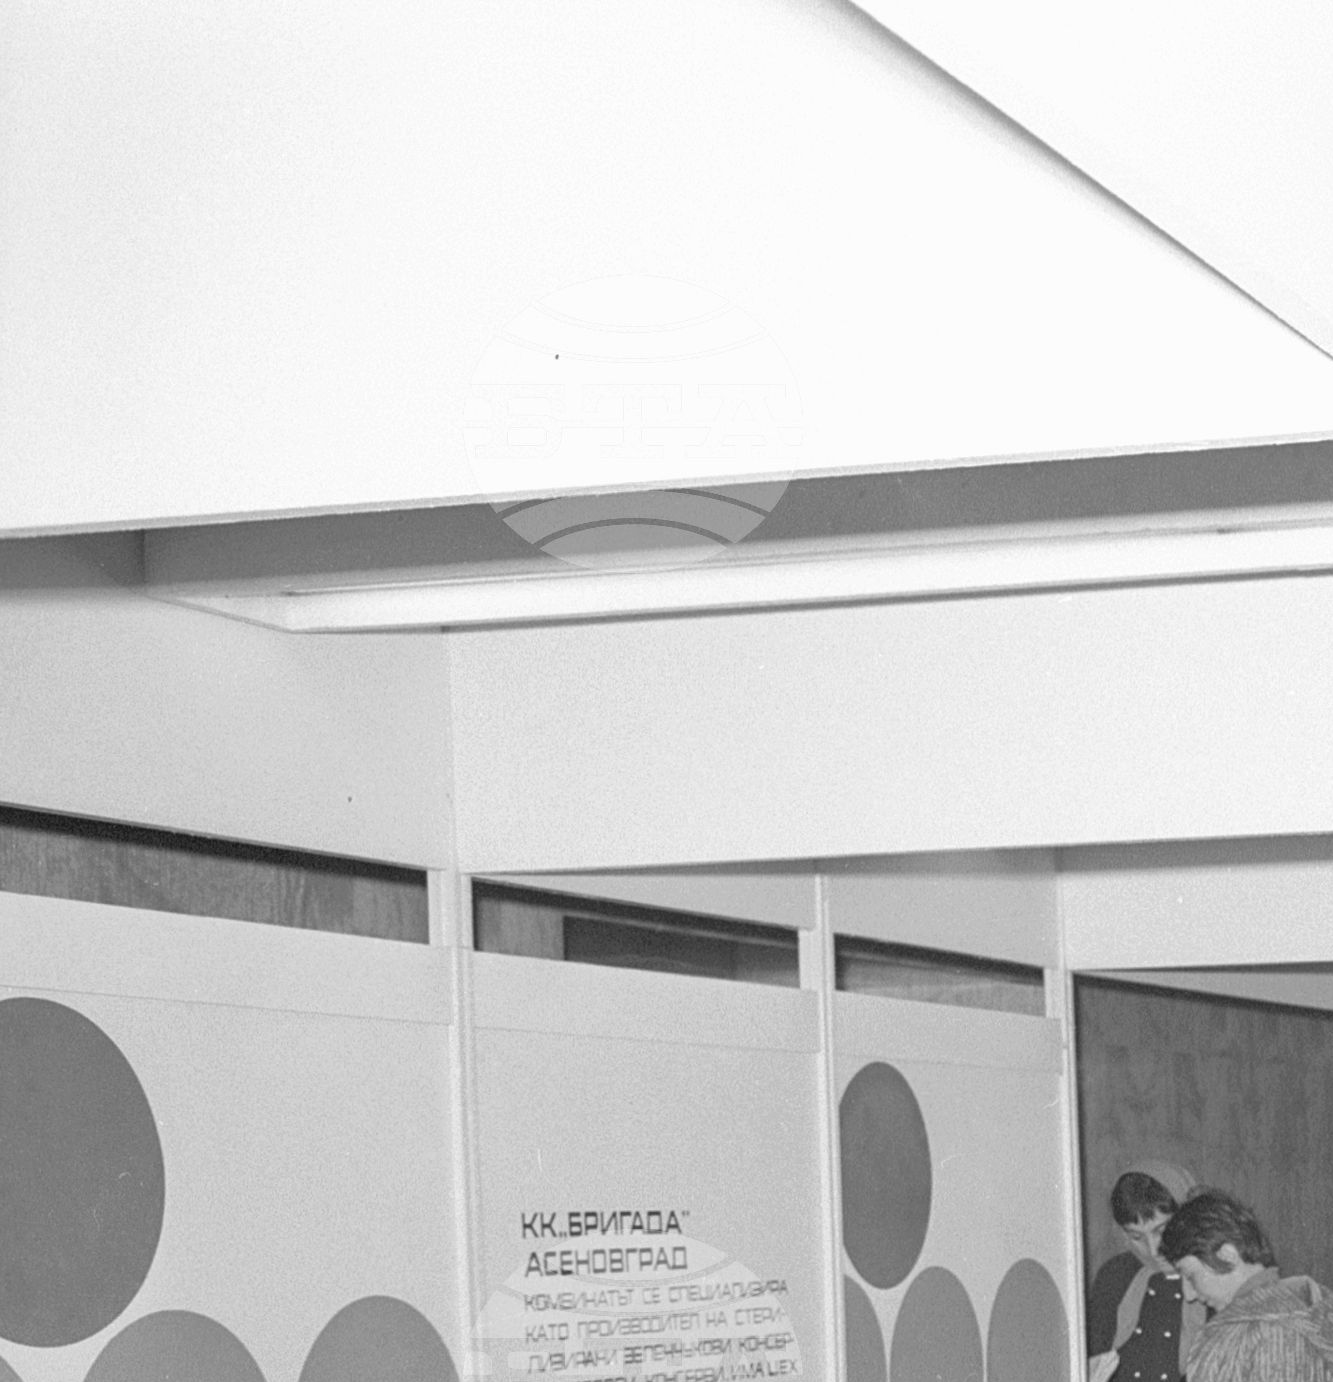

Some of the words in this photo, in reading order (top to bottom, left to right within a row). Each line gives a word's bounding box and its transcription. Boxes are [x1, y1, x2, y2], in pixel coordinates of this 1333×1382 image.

[524, 1246, 688, 1278] АСЕНОВГРАД
[523, 1289, 634, 1312] КОМБИНАТЪТ
[642, 1287, 661, 1305] СЕ
[669, 1279, 790, 1303] СПЕЦИАЛИЗИРА
[524, 1322, 569, 1343] КАТО
[576, 1313, 700, 1338] ПРОИЗВОДИТЕЛ
[705, 1310, 728, 1329] НА
[527, 1349, 618, 1374] ЛИЗИРАНИ
